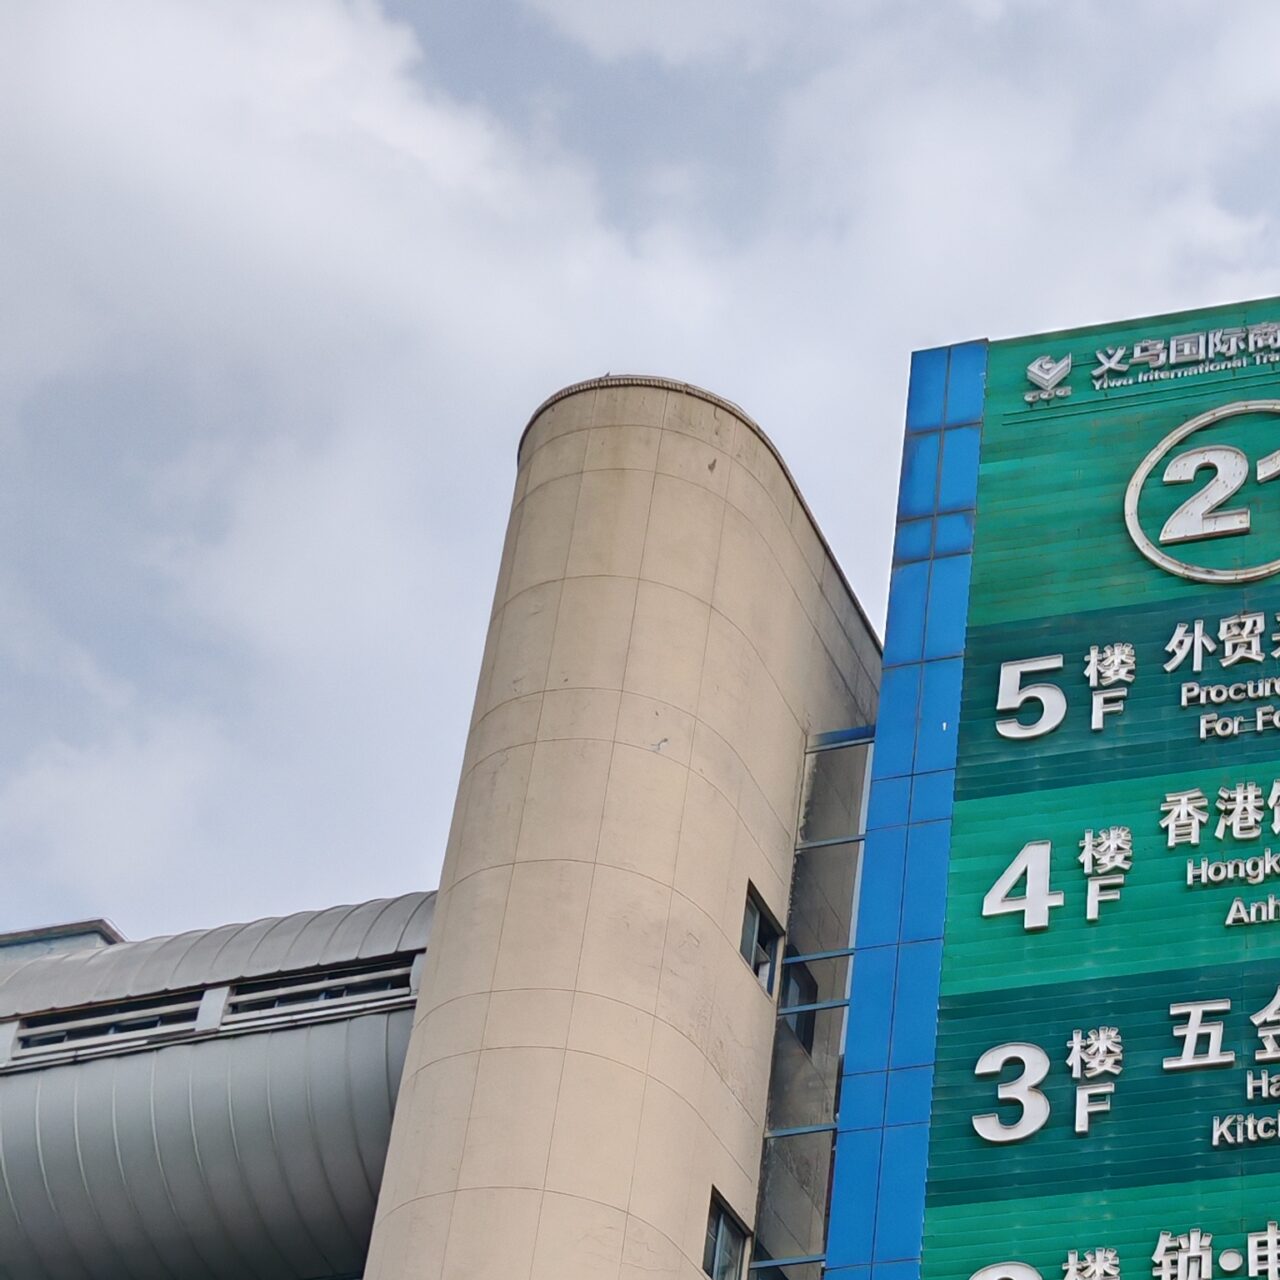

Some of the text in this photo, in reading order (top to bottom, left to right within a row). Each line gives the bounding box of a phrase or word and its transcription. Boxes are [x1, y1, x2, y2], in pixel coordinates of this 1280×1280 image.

[1092, 374, 1133, 390] Yiwu
[1138, 356, 1247, 383] International
[1083, 642, 1136, 688] 楼
[995, 654, 1067, 740] 5
[1091, 687, 1127, 730] F
[1200, 712, 1244, 740] For
[1078, 826, 1133, 875] 楼
[982, 840, 1064, 930] 4
[1086, 874, 1124, 920] F
[1065, 1025, 1123, 1079] 楼
[972, 1041, 1051, 1142] 3
[1075, 1082, 1115, 1133] F
